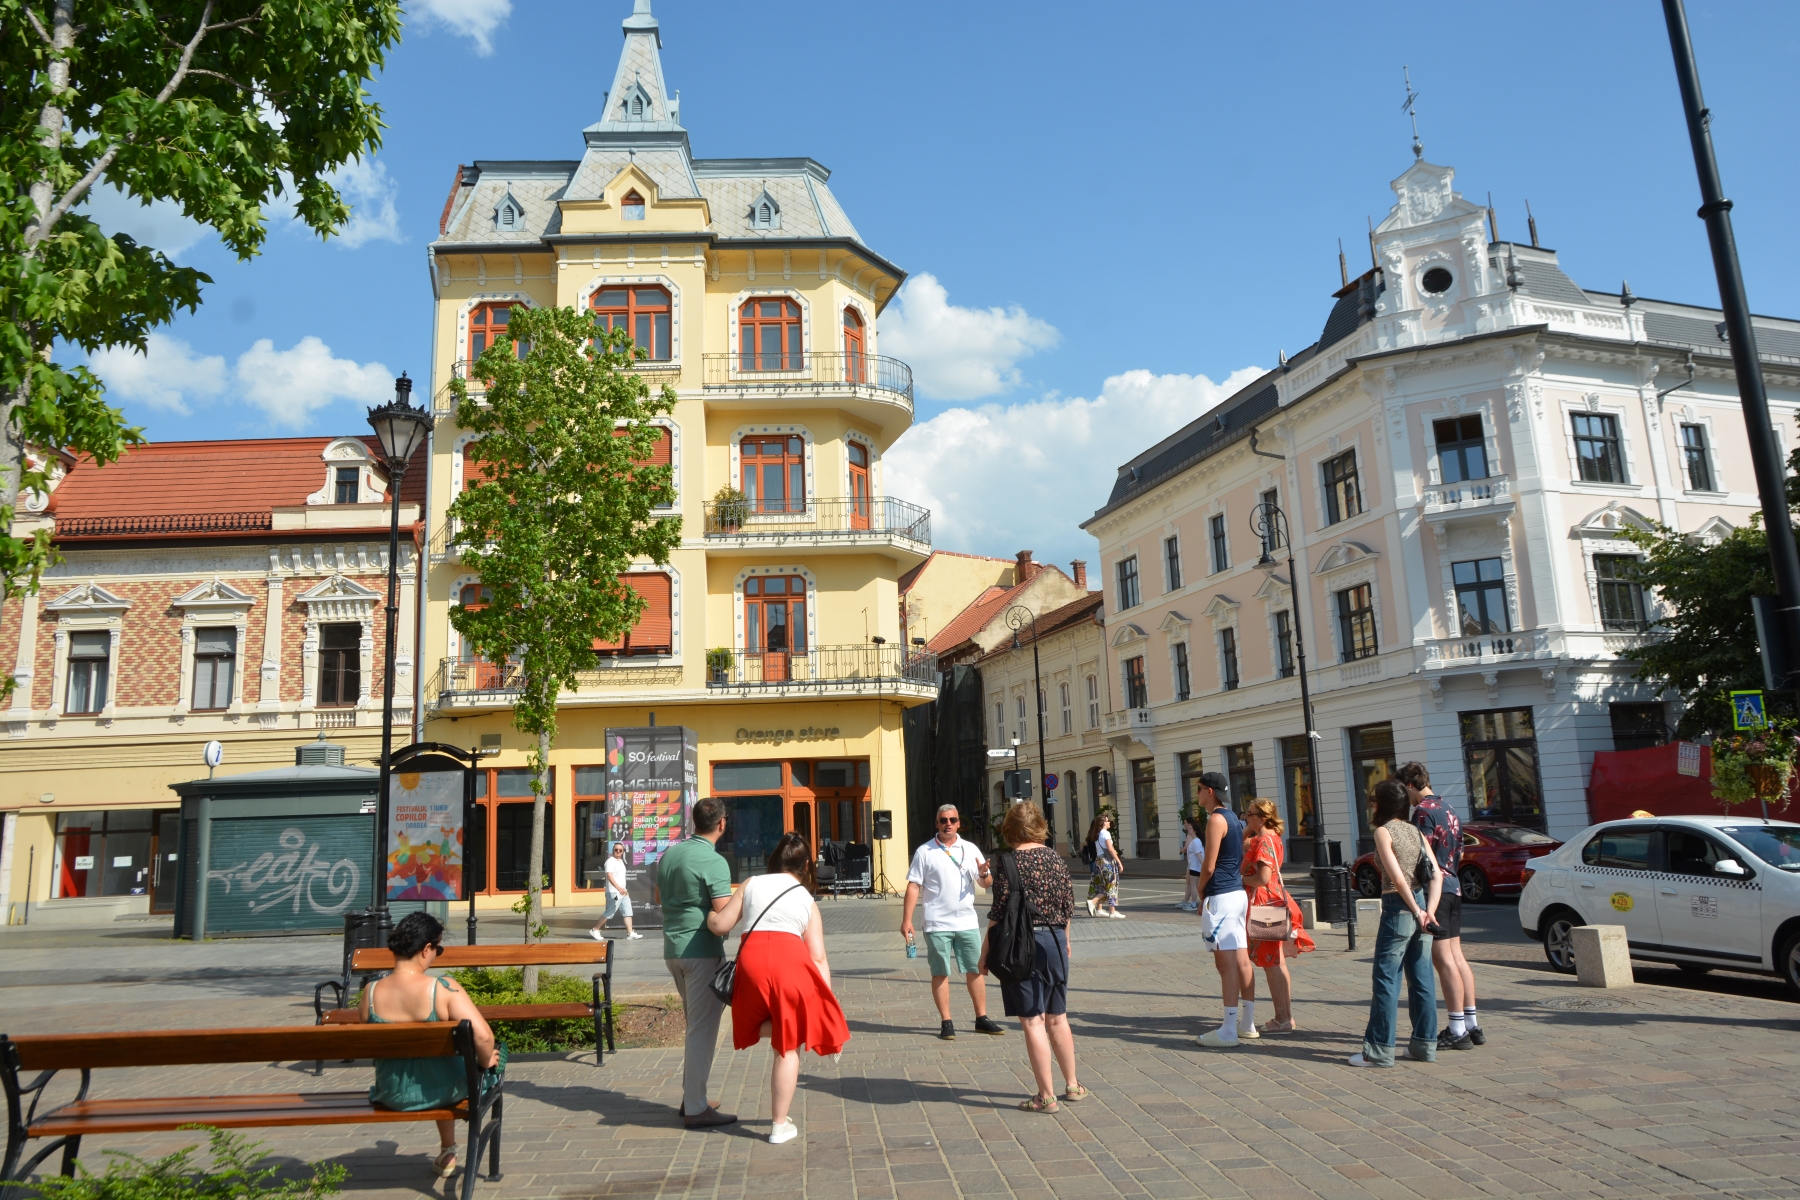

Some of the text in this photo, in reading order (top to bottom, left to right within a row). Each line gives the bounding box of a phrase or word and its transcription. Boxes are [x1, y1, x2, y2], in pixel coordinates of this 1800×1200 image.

[736, 726, 840, 742] Orange store
[628, 751, 680, 764] SO festival
[608, 778, 680, 790] 13-15 iunie
[396, 813, 427, 822] COPIILOR
[633, 823, 660, 831] Evening
